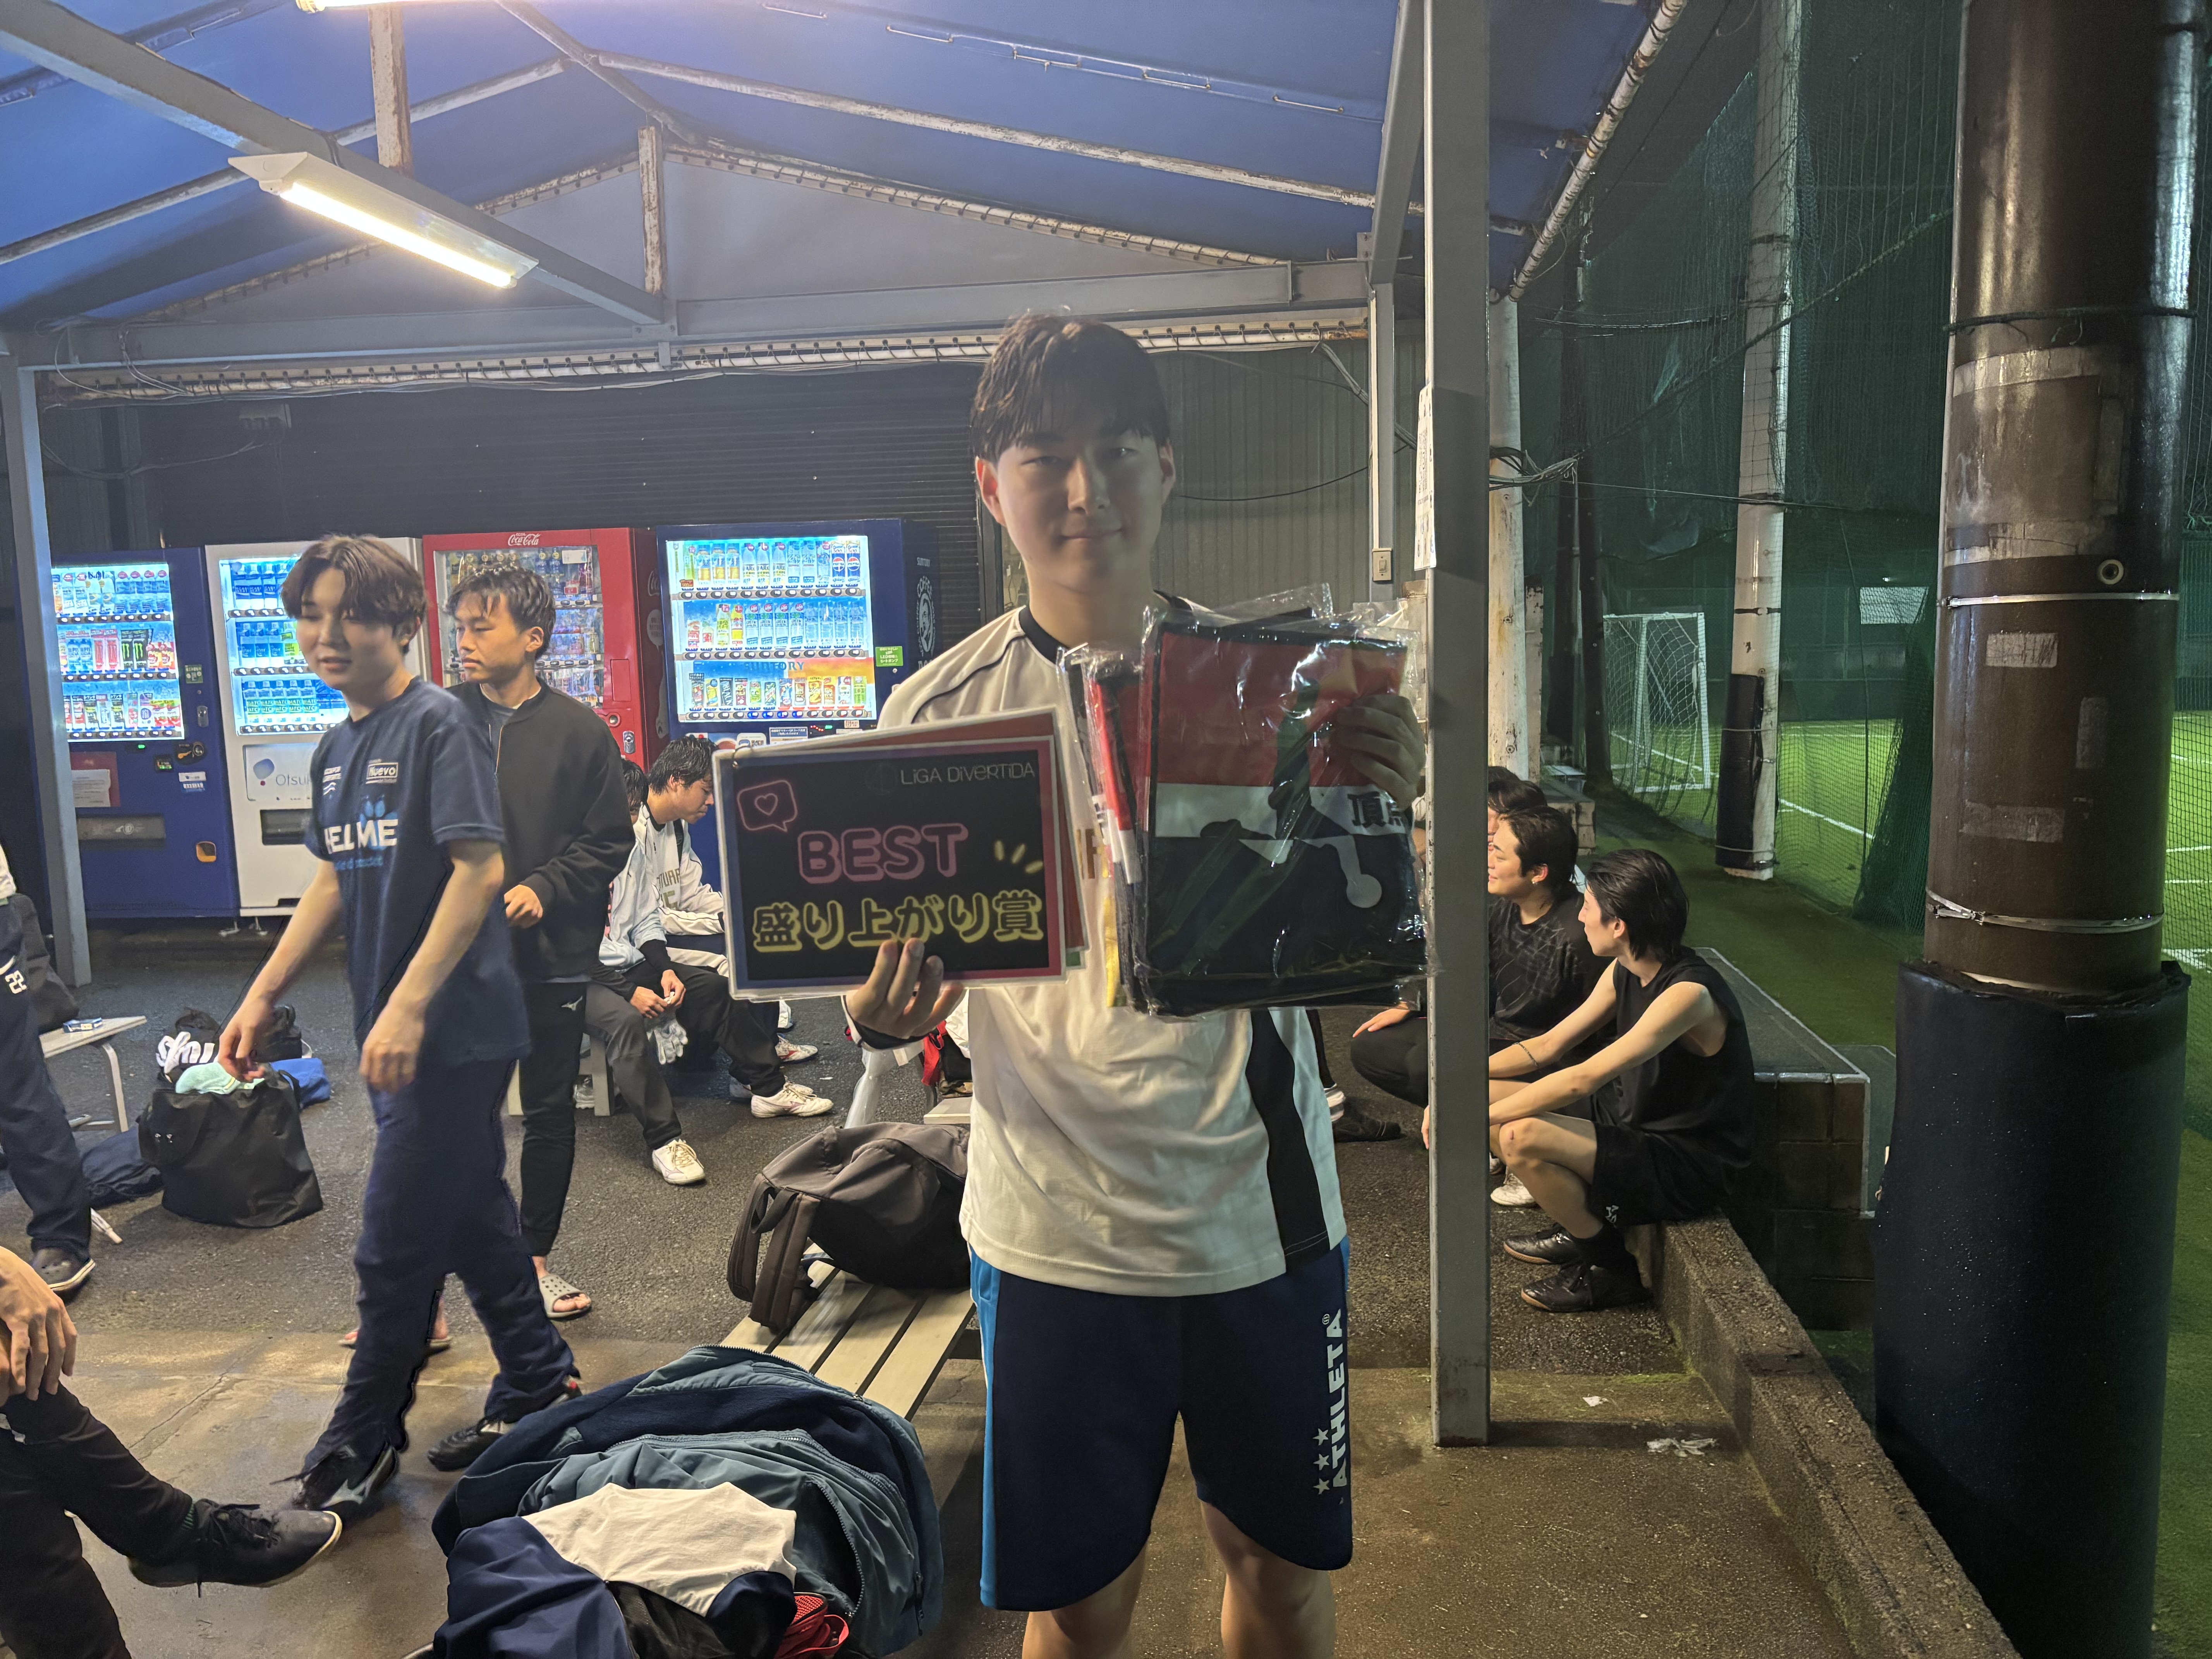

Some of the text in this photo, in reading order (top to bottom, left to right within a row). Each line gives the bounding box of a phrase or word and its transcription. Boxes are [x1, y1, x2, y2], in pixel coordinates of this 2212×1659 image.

[508, 533, 541, 546] Coca-Cola
[917, 575, 933, 599] COFFEE
[744, 661, 805, 671] SUNTORY
[798, 822, 968, 884] BEST
[752, 889, 1044, 953] 盛り上がり賞
[1326, 1308, 1348, 1487] ATHLETA
